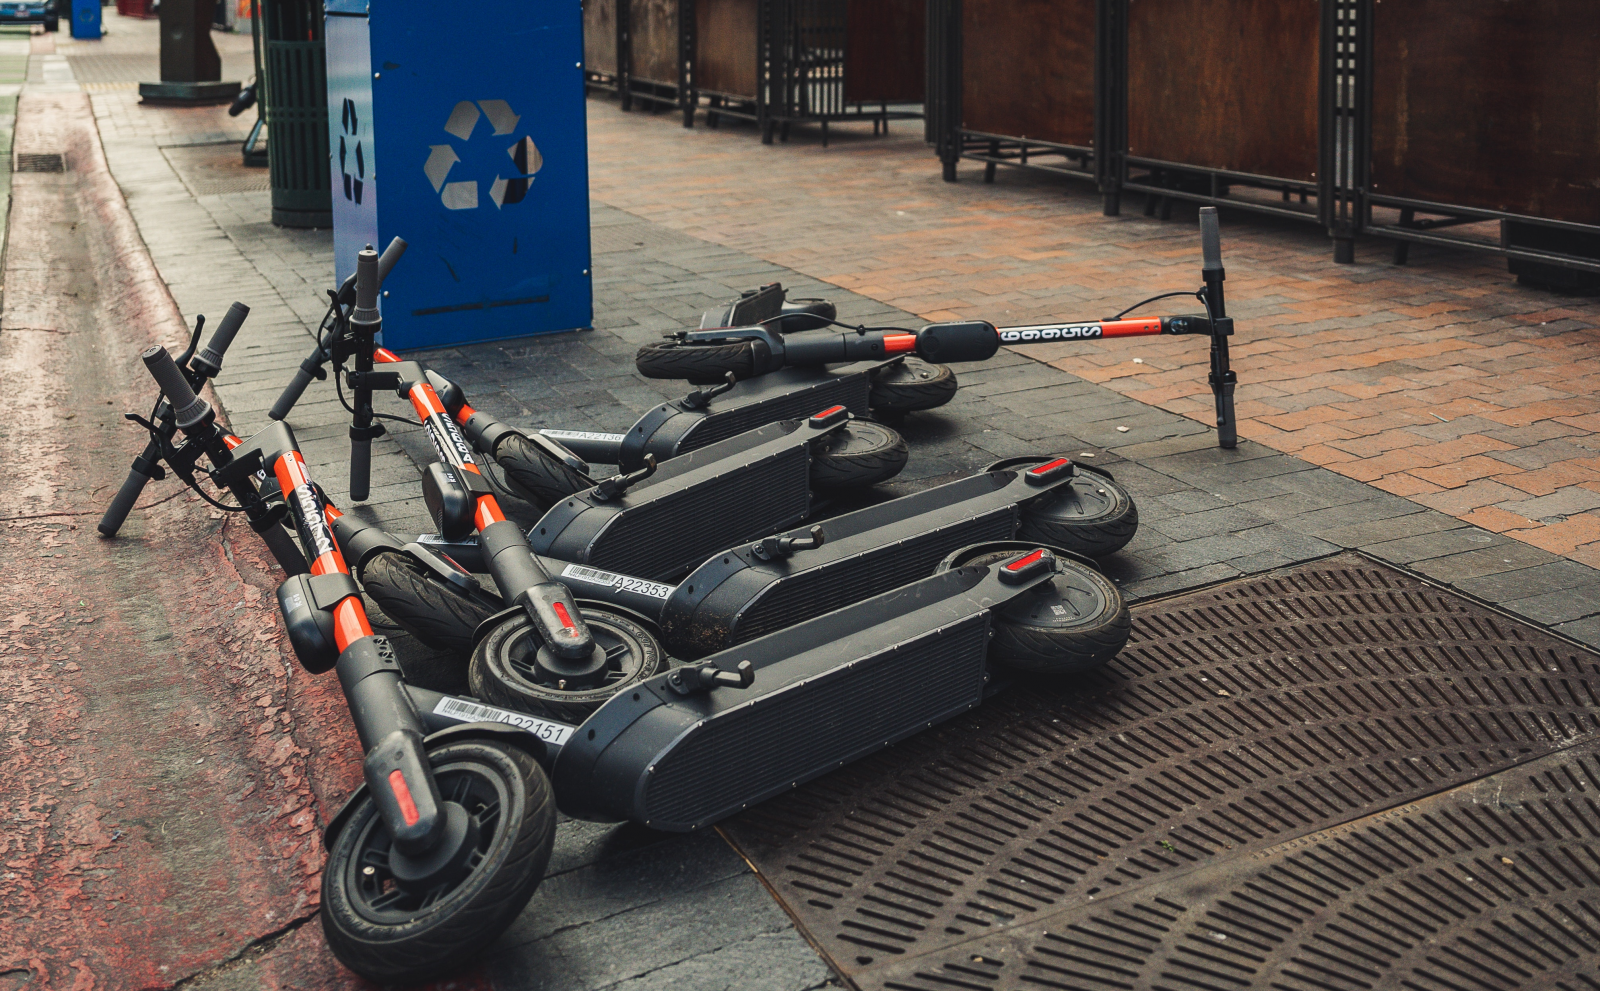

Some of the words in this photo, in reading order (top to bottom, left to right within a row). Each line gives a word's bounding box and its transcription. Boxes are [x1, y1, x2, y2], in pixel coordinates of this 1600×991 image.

[1001, 326, 1102, 342] S5669
[578, 432, 622, 441] A22136
[297, 483, 333, 555] S5572
[612, 577, 669, 597] A22353
[500, 714, 566, 742] A22151
